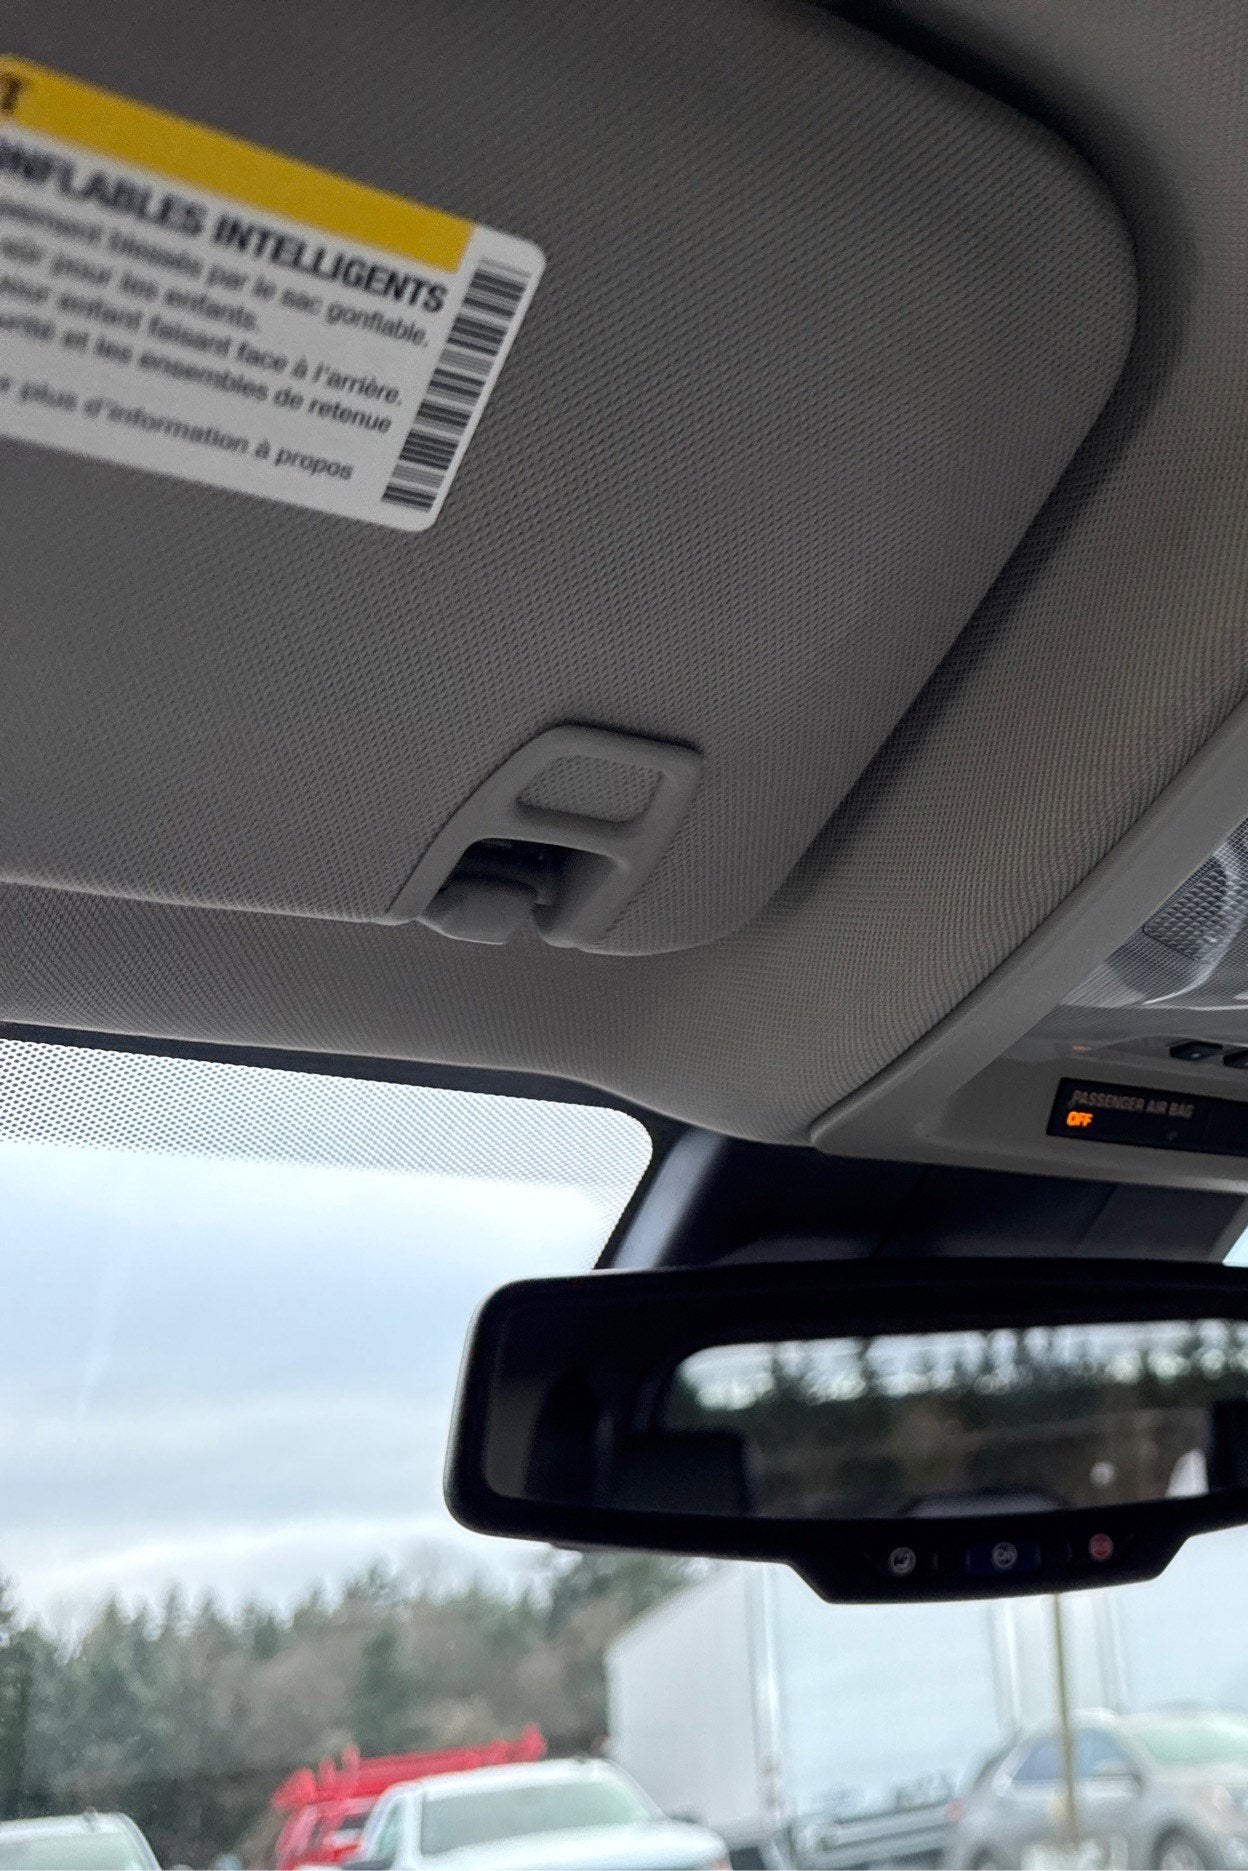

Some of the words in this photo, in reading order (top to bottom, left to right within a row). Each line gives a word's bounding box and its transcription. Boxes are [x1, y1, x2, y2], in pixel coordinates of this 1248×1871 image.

[118, 272, 159, 300] les
[163, 288, 259, 333] enfants.
[210, 213, 448, 313] INTELLIGENTS
[205, 263, 248, 294] par
[252, 275, 277, 300] le
[281, 287, 321, 316] sac
[324, 301, 428, 348] gonflable.
[57, 292, 143, 332] enfant
[148, 313, 233, 356] faisant
[235, 341, 288, 374] face
[290, 355, 309, 381] à
[312, 360, 402, 407] l'arrière.
[61, 329, 90, 350] et
[93, 334, 132, 368] les
[137, 351, 269, 402] ensembles
[272, 386, 304, 410] de
[308, 398, 392, 434] retenue
[83, 397, 249, 455] d'information
[255, 438, 271, 460] à
[274, 447, 354, 480] propos
[1067, 1111, 1093, 1128] OFF
[1073, 1090, 1144, 1112] PASSENGER
[1147, 1101, 1168, 1115] AIR
[1170, 1104, 1194, 1119] BAG
